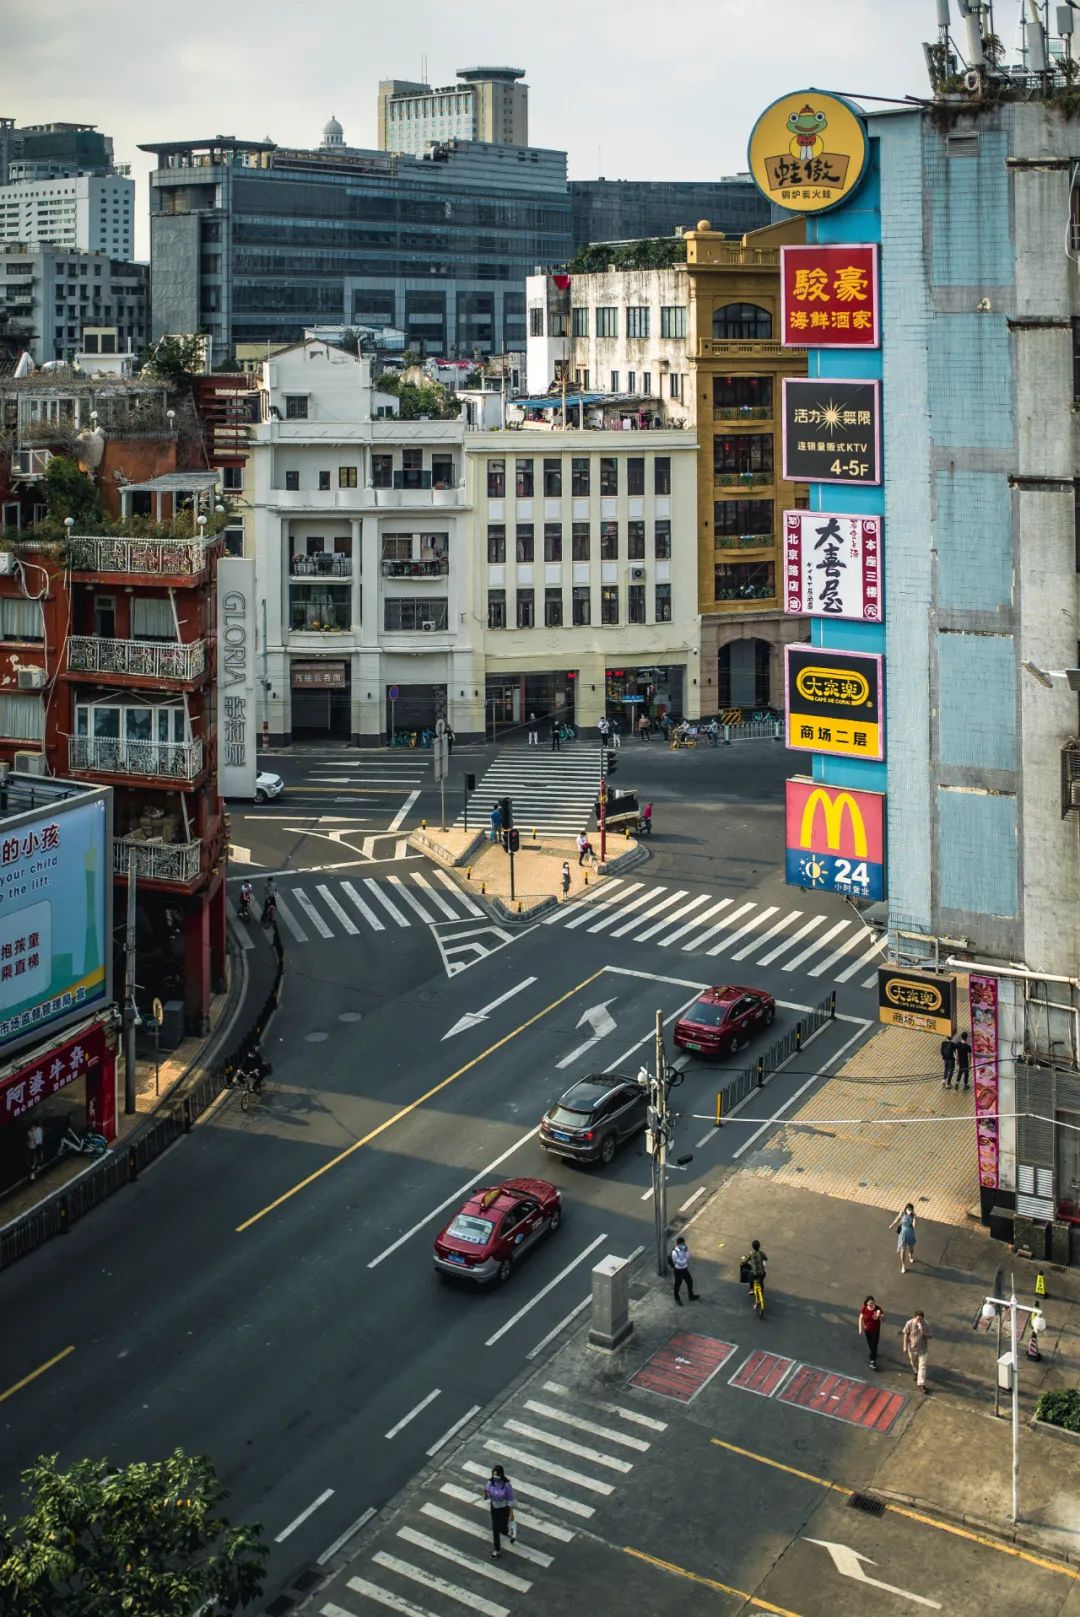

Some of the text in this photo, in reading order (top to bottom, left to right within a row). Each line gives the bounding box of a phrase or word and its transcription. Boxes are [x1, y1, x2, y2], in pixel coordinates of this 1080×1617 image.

[790, 310, 872, 330] 海鮮酒家
[830, 458, 869, 477] 4-5F
[788, 533, 799, 592] 北京路店
[814, 517, 847, 613] 大喜屋
[223, 590, 246, 688] GLORIA
[224, 695, 246, 767] 歌莉娅
[800, 724, 867, 747] 商场二层
[30, 856, 58, 873] child
[834, 859, 870, 887] 24
[9, 885, 27, 898] the
[892, 1012, 937, 1030] 商场二层
